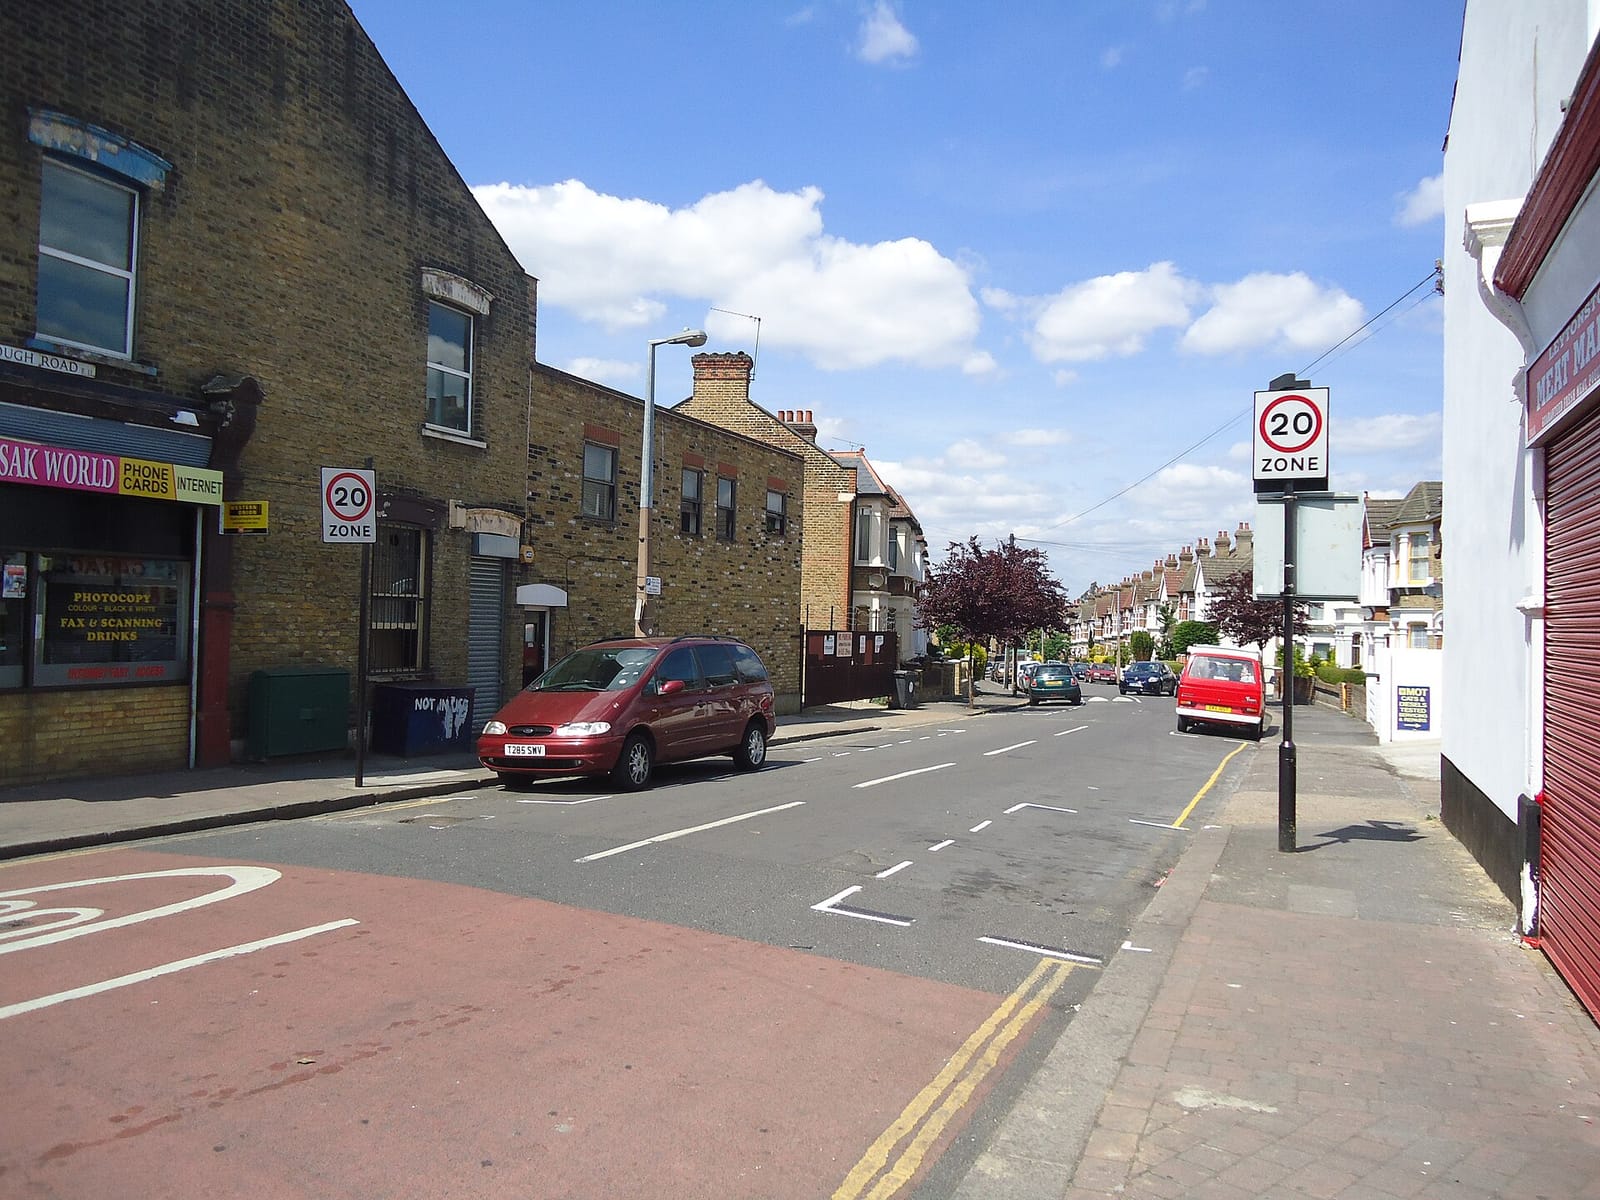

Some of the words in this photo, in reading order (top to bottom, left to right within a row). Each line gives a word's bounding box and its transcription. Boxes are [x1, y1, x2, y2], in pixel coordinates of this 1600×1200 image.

[41, 355, 79, 373] ROAD
[1537, 349, 1569, 412] MEAT
[1271, 411, 1313, 436] 20
[0, 444, 38, 480] SAK
[44, 450, 115, 489] WORLD
[124, 463, 169, 481] PHONE
[1261, 456, 1319, 472] ZONE
[123, 477, 169, 494] CARDS
[177, 476, 222, 494] INTERNET
[334, 486, 366, 507] 20
[329, 524, 371, 537] ZONE
[74, 592, 151, 603] PHOTOCOPY
[60, 618, 85, 628] FAX
[89, 619, 97, 628] &
[101, 618, 162, 628] SCANNING
[87, 631, 138, 641] DRINKS
[1407, 688, 1428, 697] MOT
[415, 697, 436, 711] NOT
[507, 745, 526, 755] T285
[527, 745, 542, 755] SMV
